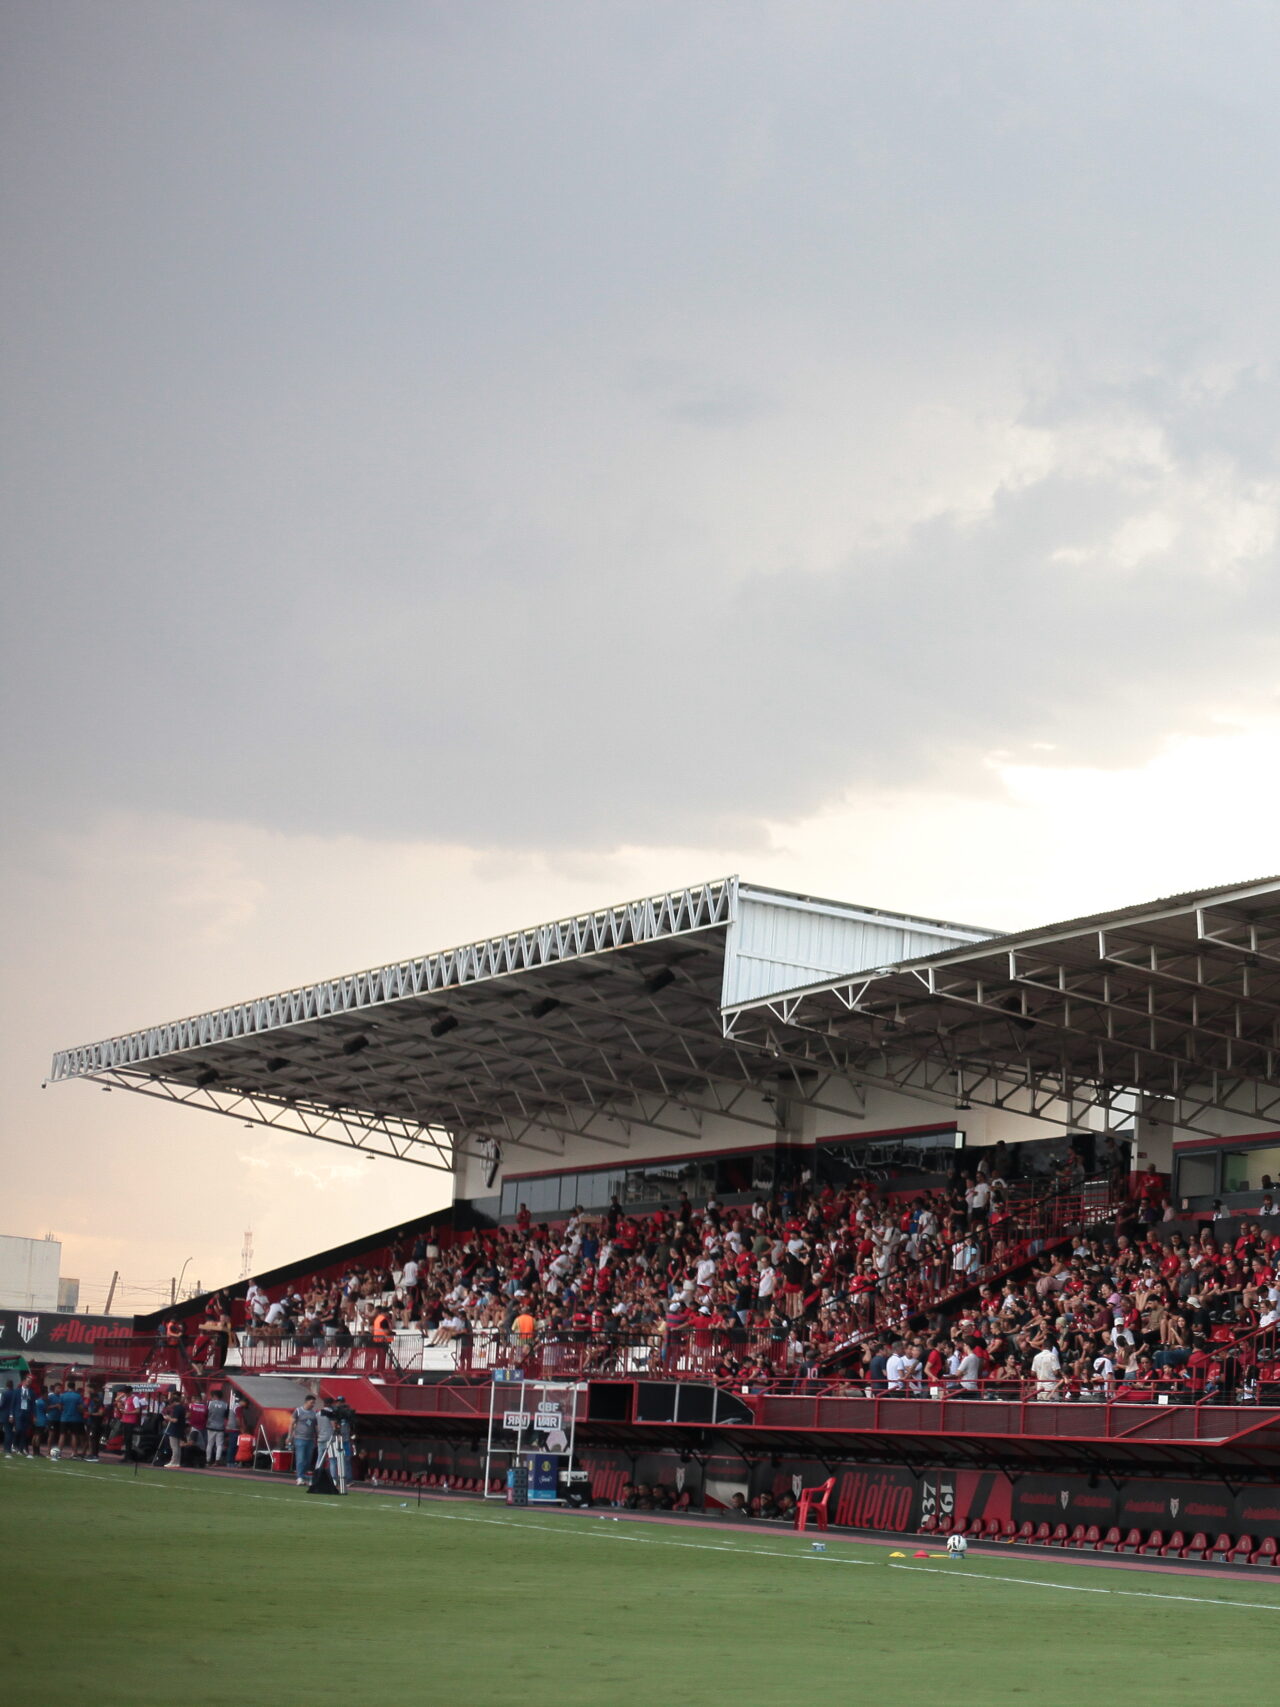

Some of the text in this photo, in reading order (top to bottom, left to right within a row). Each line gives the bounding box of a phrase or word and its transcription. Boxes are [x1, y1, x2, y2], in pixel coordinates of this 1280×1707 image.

[806, 1367, 819, 1379] 10
[537, 1416, 558, 1427] VAR
[834, 1471, 913, 1532] Atlético
